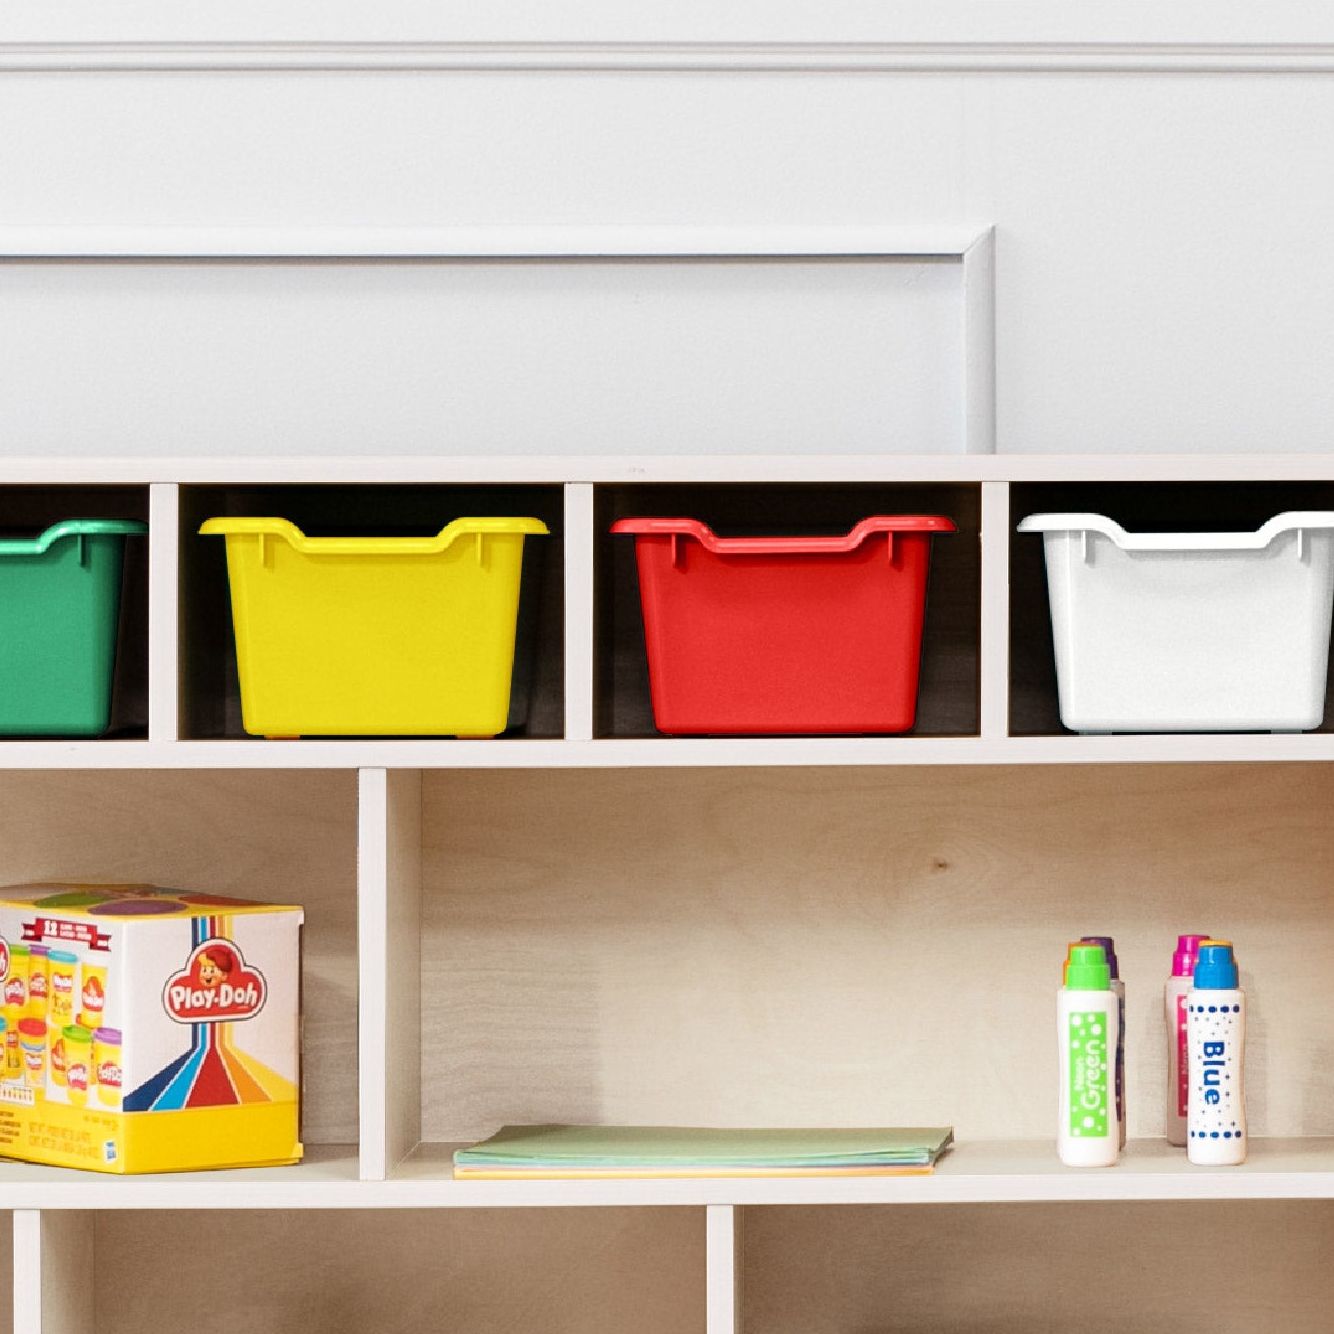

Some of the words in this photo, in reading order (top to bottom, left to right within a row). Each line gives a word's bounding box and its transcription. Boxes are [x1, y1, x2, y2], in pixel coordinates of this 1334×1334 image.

[171, 982, 258, 1011] Play-Doh
[1081, 1040, 1101, 1110] Green
[1203, 1041, 1226, 1105] Blue
